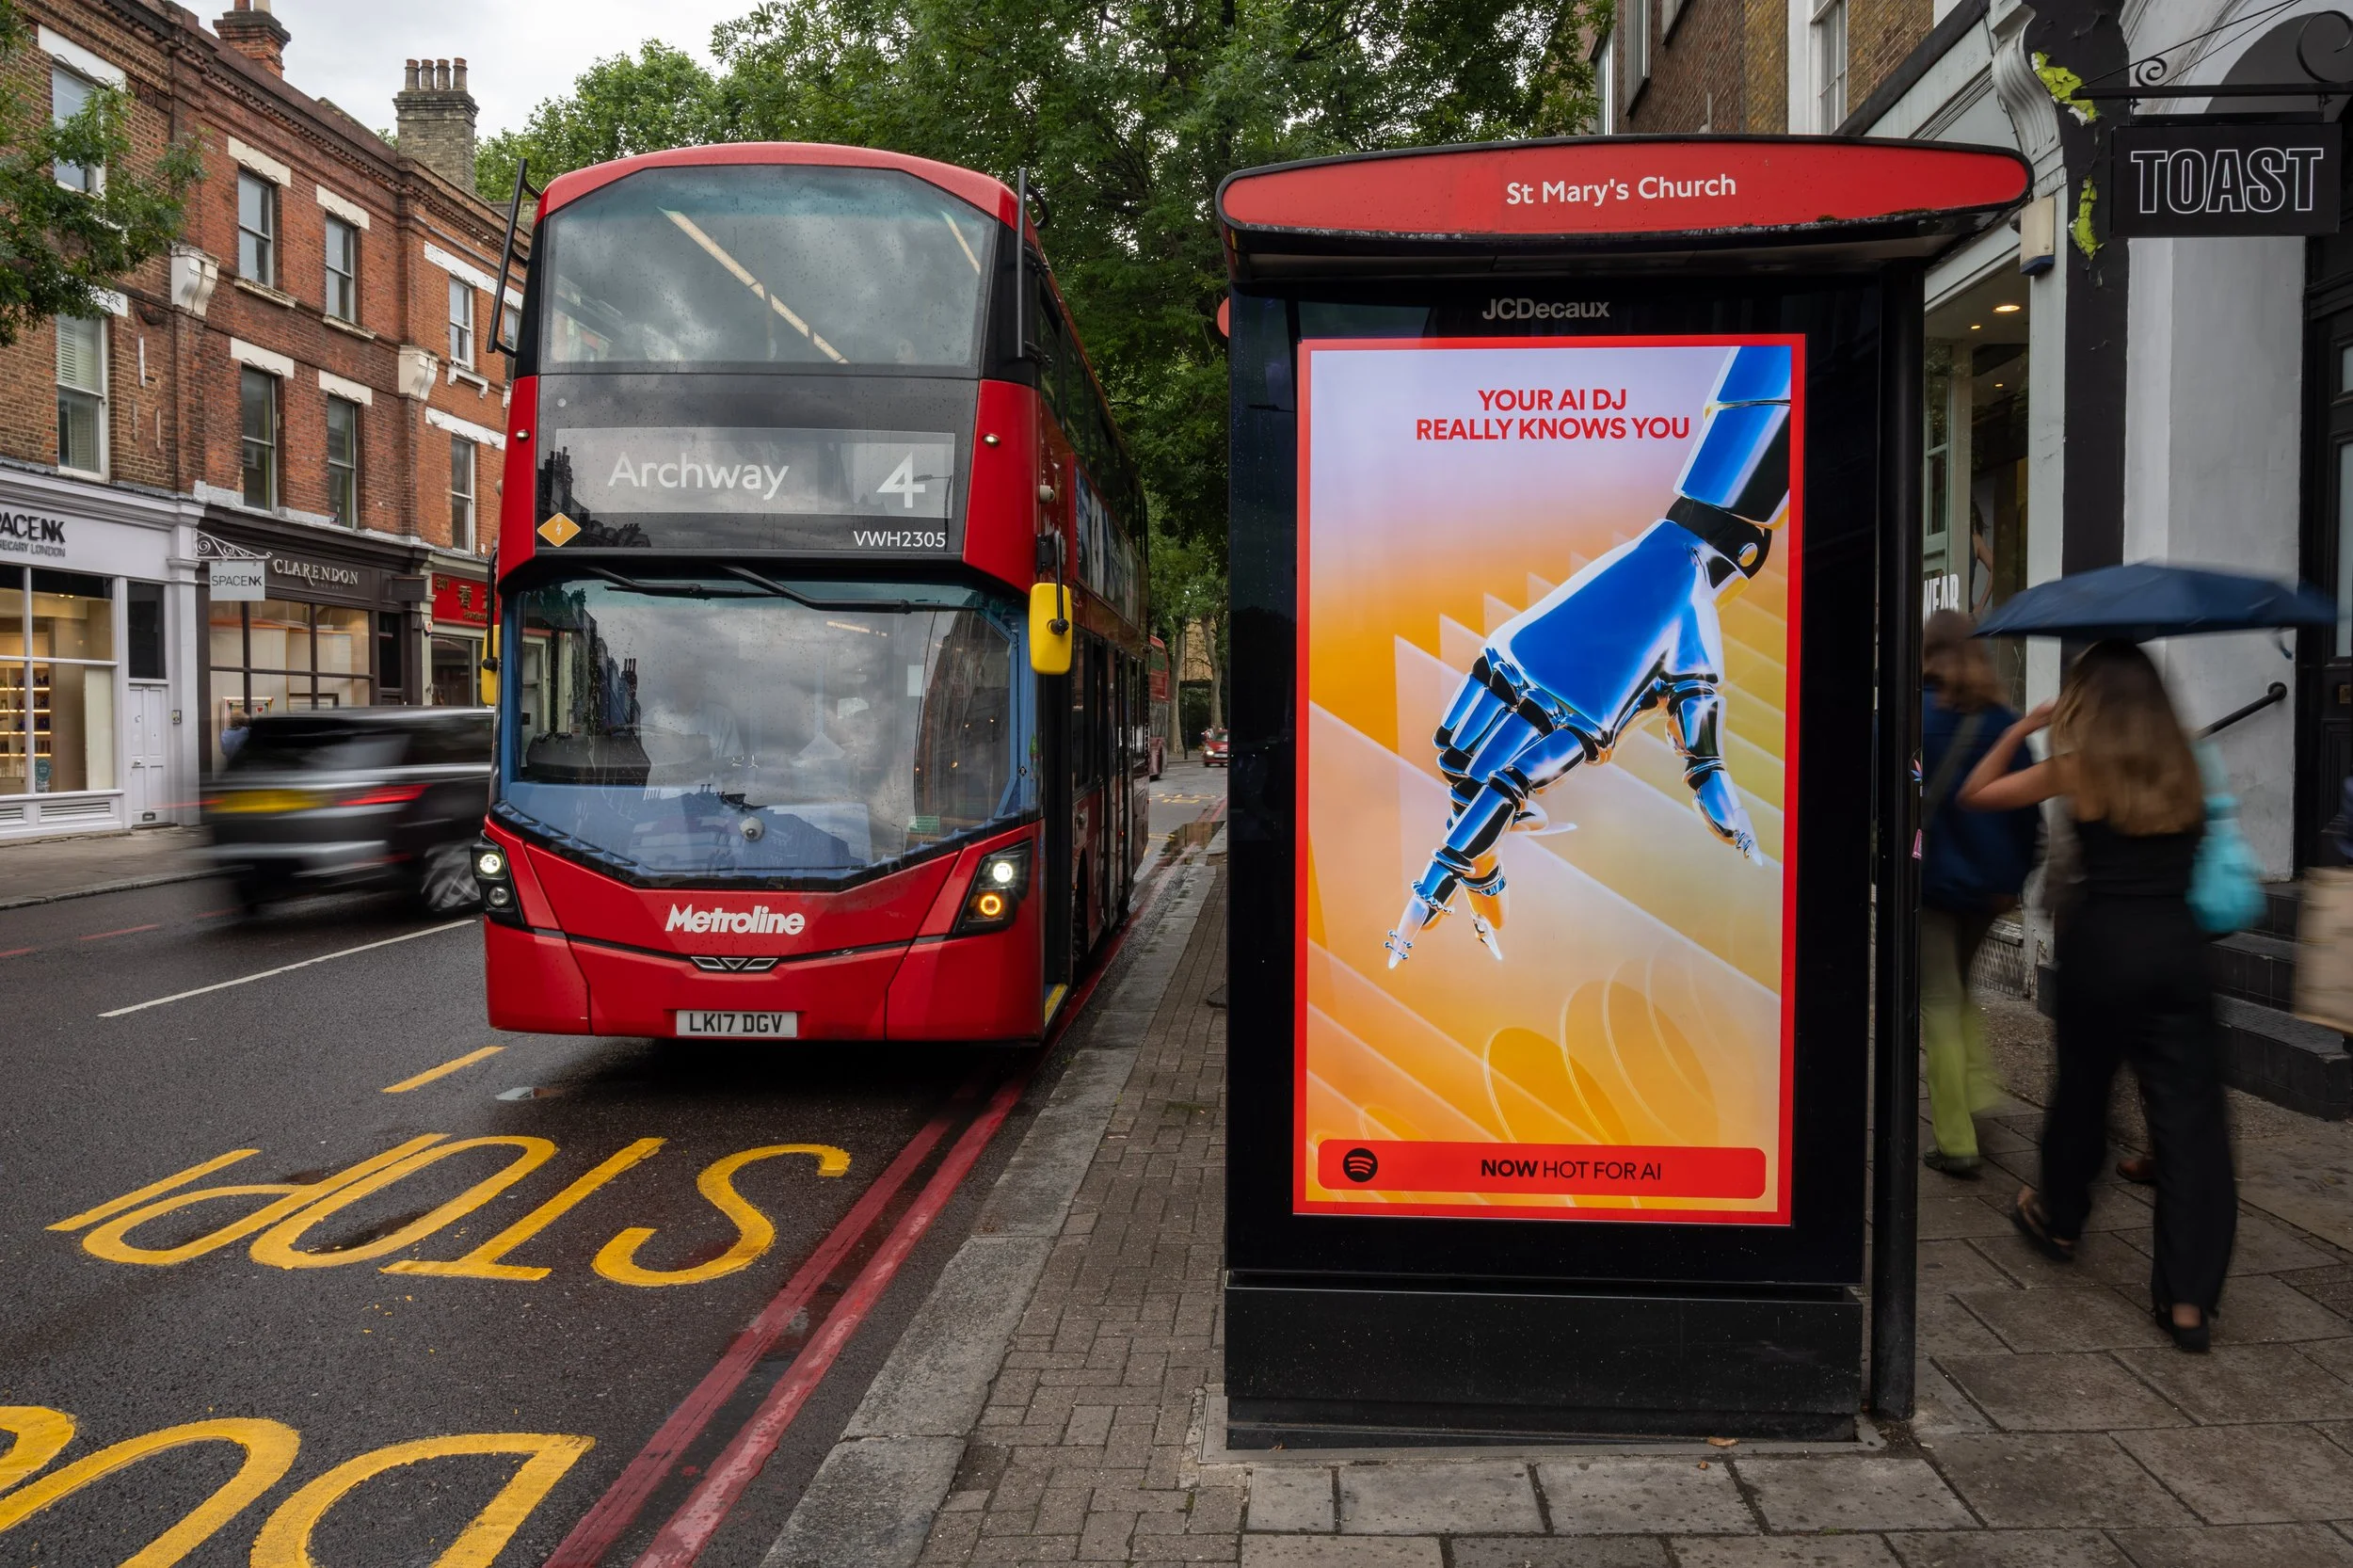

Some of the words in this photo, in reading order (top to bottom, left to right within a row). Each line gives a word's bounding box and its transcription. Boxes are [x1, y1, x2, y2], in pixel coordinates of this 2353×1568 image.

[1506, 182, 1534, 205] St
[1542, 178, 1629, 207] Mary's
[1638, 174, 1737, 200] Church
[2130, 147, 2324, 215] TOAST
[1481, 298, 1610, 321] JCDecaux
[1479, 389, 1554, 411] YOUR
[1558, 389, 1586, 410] AI
[1593, 389, 1626, 410] DJ
[1417, 417, 1513, 440] REALLY
[1518, 417, 1627, 440] KNOWS
[1631, 416, 1690, 440] YOU
[605, 451, 790, 509] Archway
[875, 451, 926, 509] 4
[0, 538, 29, 552] ECARY
[31, 543, 66, 558] LONDON
[853, 530, 946, 549] VWH2305
[272, 558, 359, 587] CLARENDON
[664, 903, 806, 936] Metroline
[689, 1014, 736, 1033] LK17
[742, 1014, 783, 1033] DGV
[1481, 1159, 1539, 1177] NOW
[1543, 1160, 1590, 1178] HOT
[1593, 1161, 1637, 1179] FOR
[1641, 1162, 1661, 1180] AI
[46, 1131, 853, 1288] STOP
